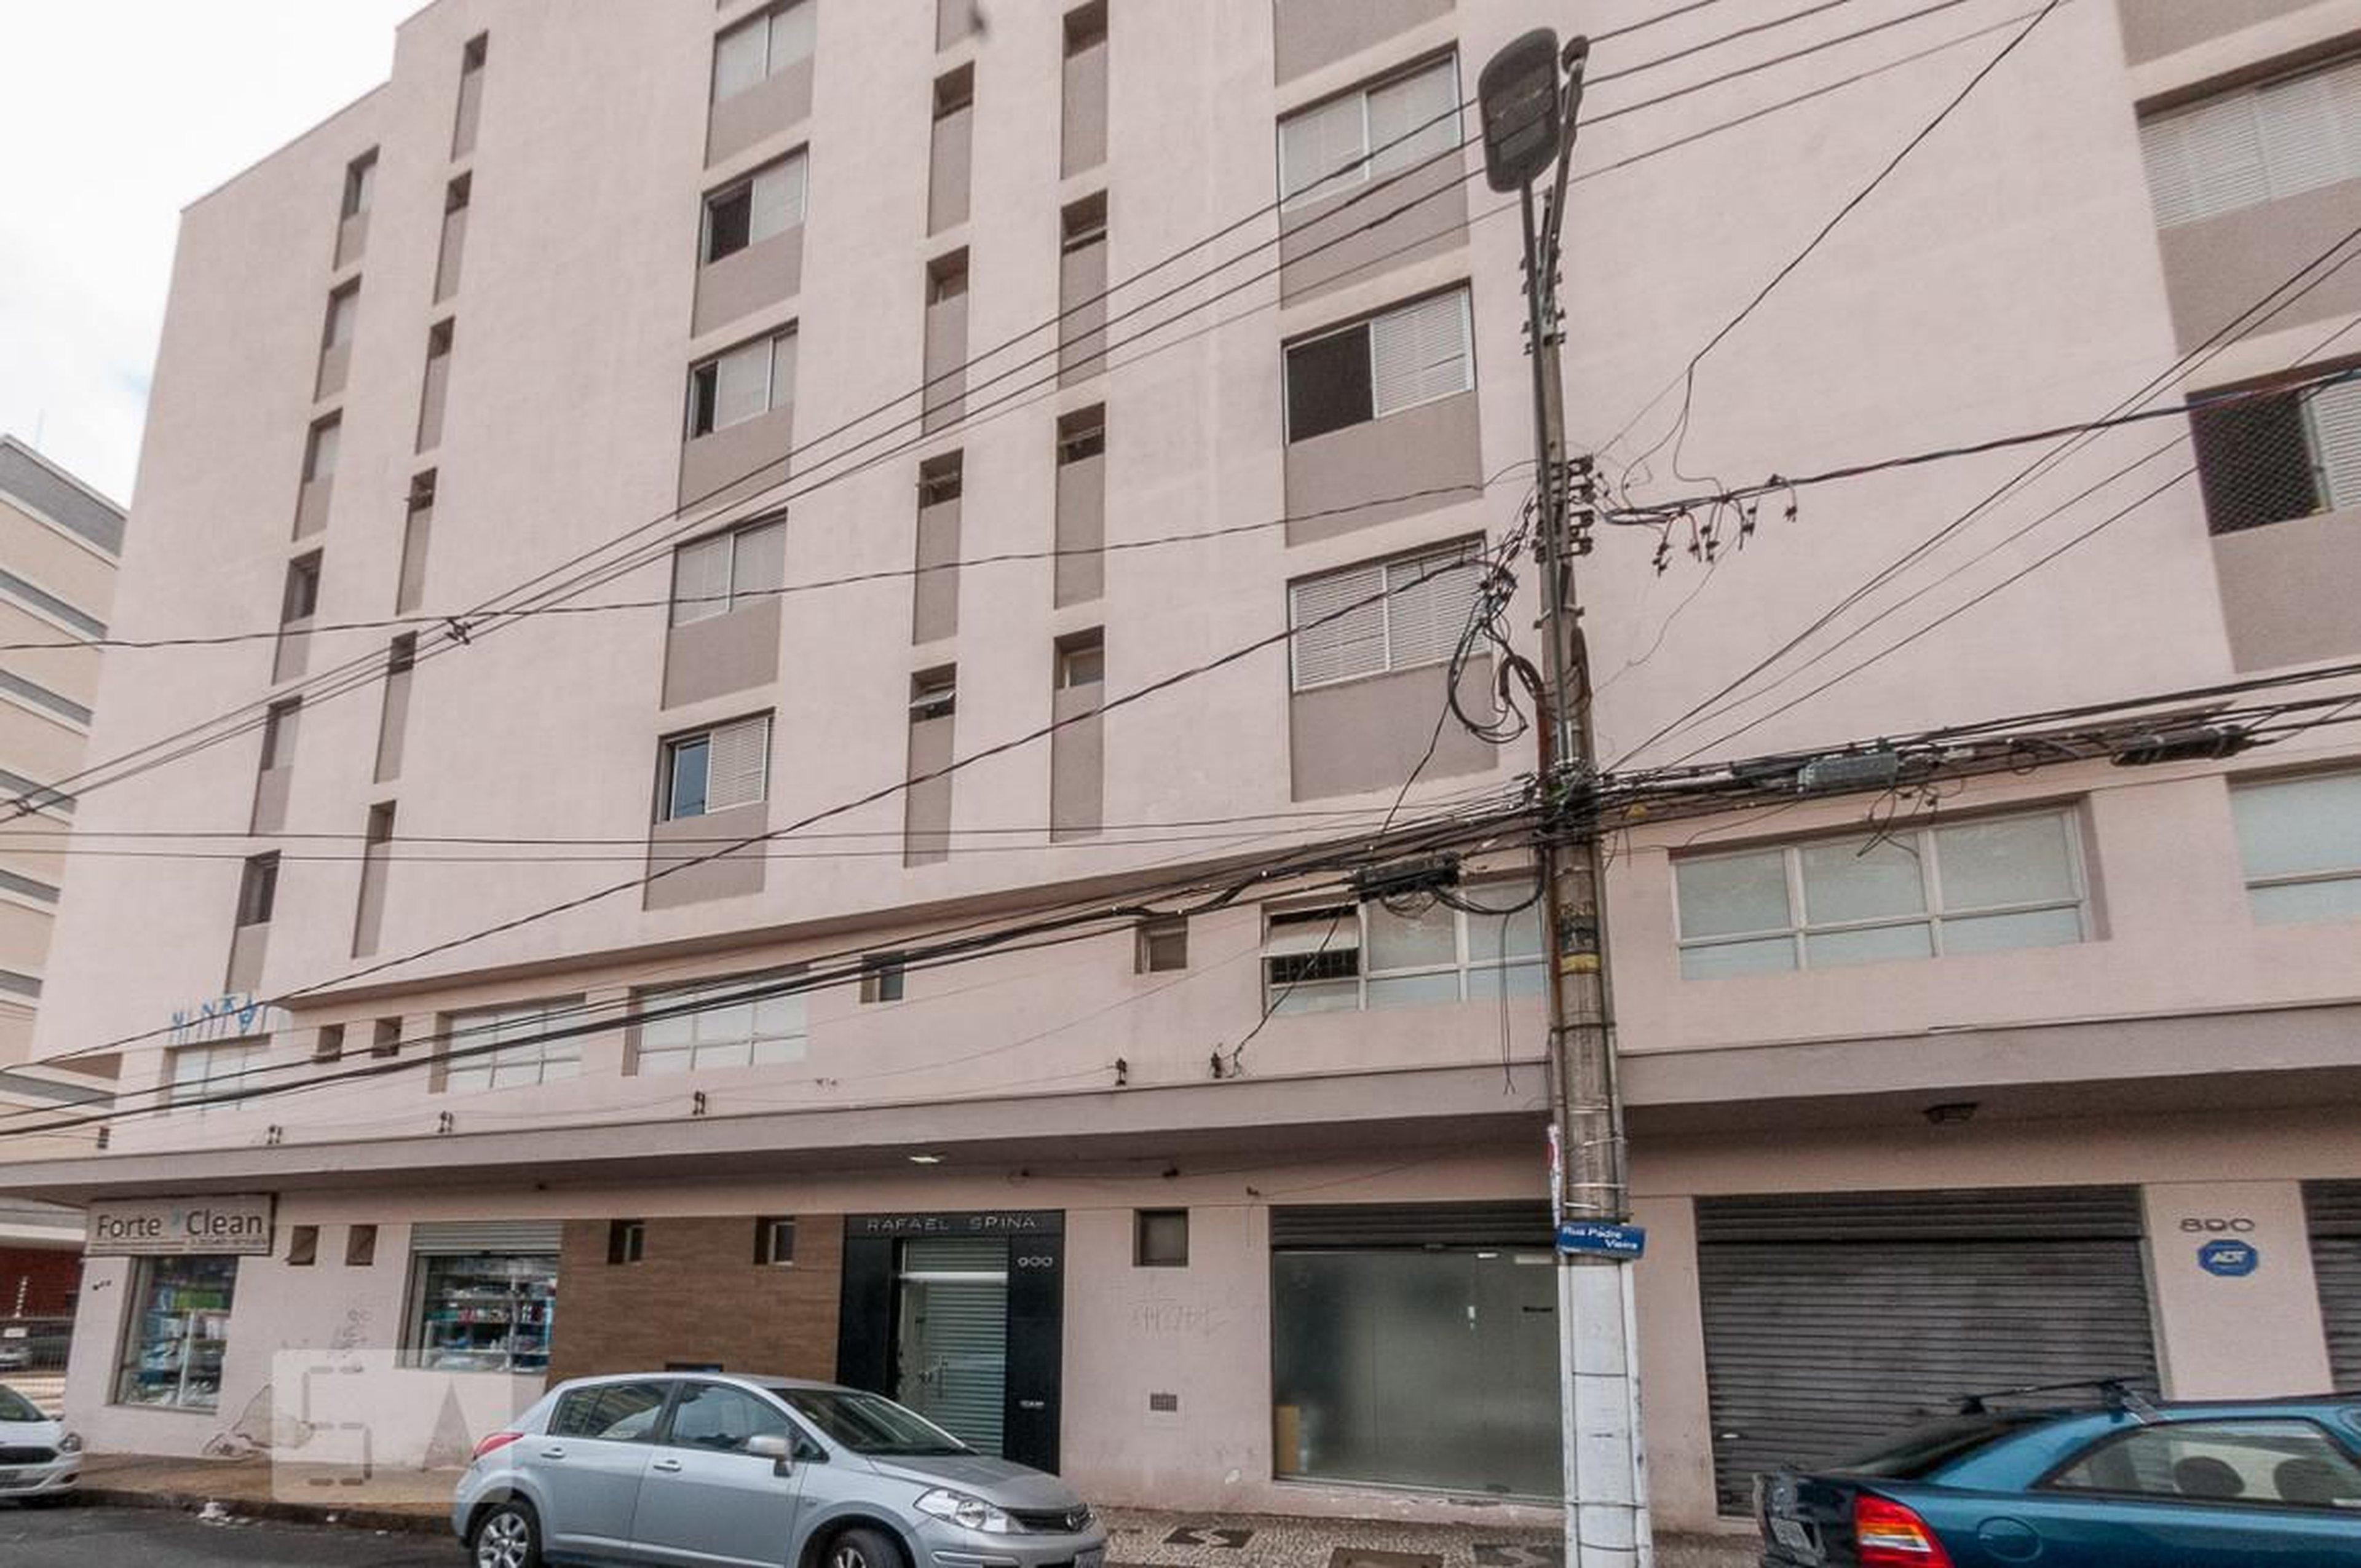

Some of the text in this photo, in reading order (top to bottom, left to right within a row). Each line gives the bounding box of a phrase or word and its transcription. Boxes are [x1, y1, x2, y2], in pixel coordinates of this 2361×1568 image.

[97, 1209, 262, 1237] Forte Clean
[867, 1215, 1037, 1232] RAFAEL SPINA
